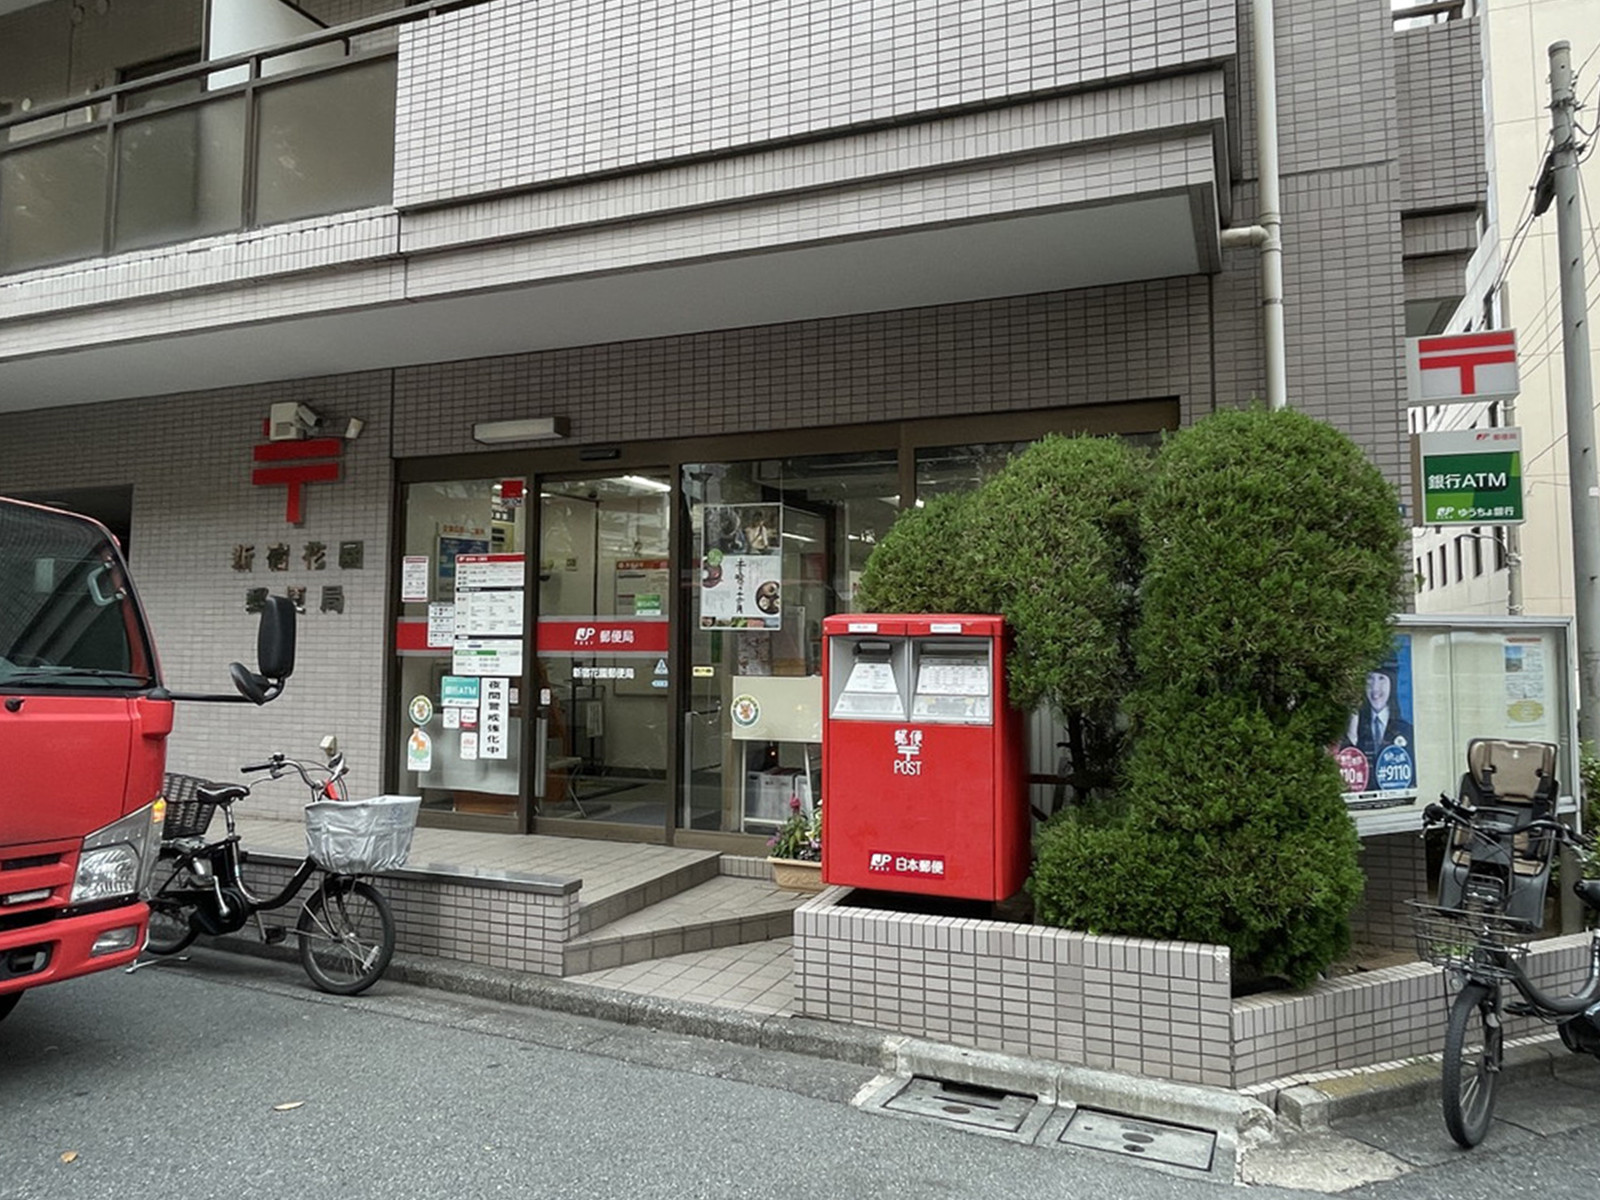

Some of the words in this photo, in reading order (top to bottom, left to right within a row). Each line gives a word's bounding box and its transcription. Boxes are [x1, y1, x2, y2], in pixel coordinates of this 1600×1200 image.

[1428, 472, 1507, 490] 銀行ATM
[1457, 506, 1515, 518] ゆうちょ銀行
[599, 629, 635, 644] 郵便局
[893, 729, 923, 747] 郵便
[894, 759, 922, 776] POST
[1377, 764, 1412, 781] #9110
[895, 856, 945, 875] 日本郵便
